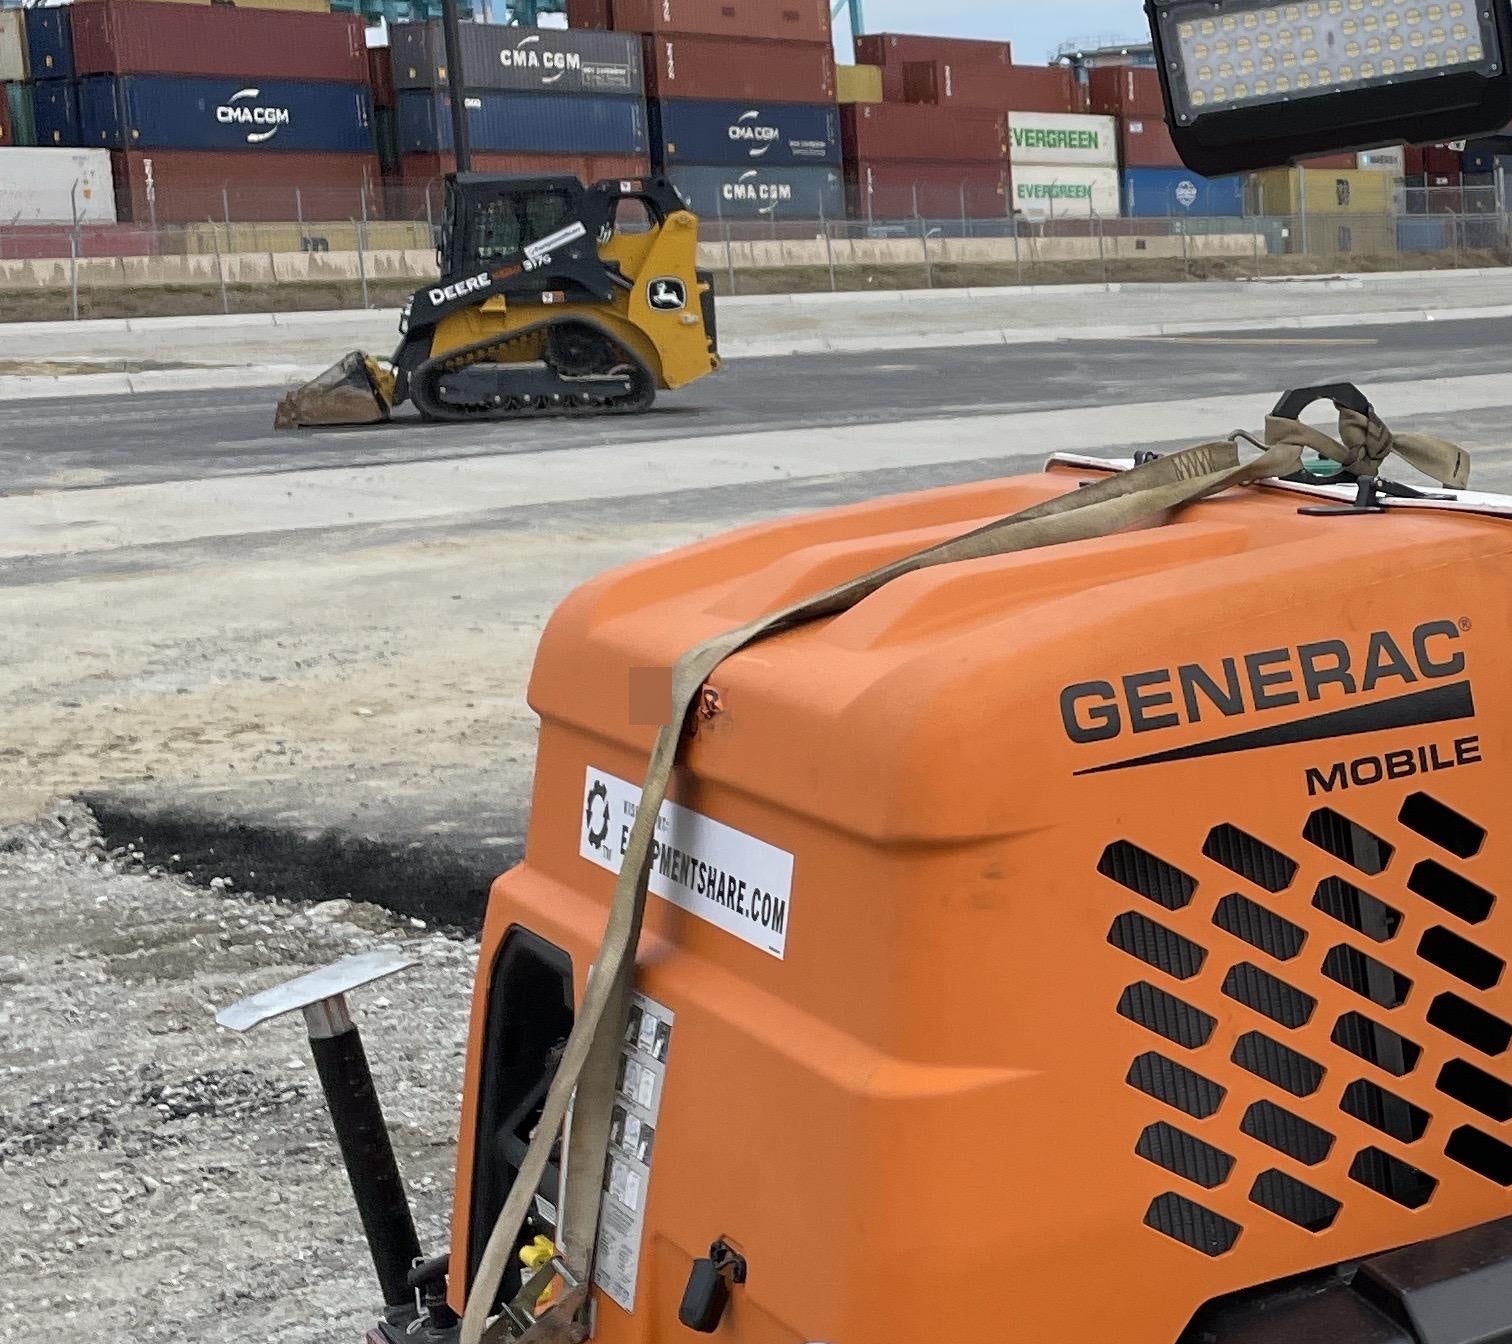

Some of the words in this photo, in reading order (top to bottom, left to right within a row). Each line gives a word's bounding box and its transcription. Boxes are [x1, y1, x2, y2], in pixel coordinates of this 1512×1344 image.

[499, 49, 540, 68] CMA
[542, 51, 581, 70] CGM
[216, 106, 253, 123] CMA
[253, 107, 290, 124] CGM
[728, 126, 754, 140] CMA
[755, 127, 779, 141] CGM
[722, 184, 757, 201] CMA
[759, 184, 792, 200] CGM
[1017, 184, 1092, 199] EVERGREEN
[428, 272, 492, 306] DEERE
[1059, 619, 1467, 744] GENERAC
[1304, 735, 1483, 796] MOBILE
[620, 824, 786, 935] EPMENTSHARE.COM
